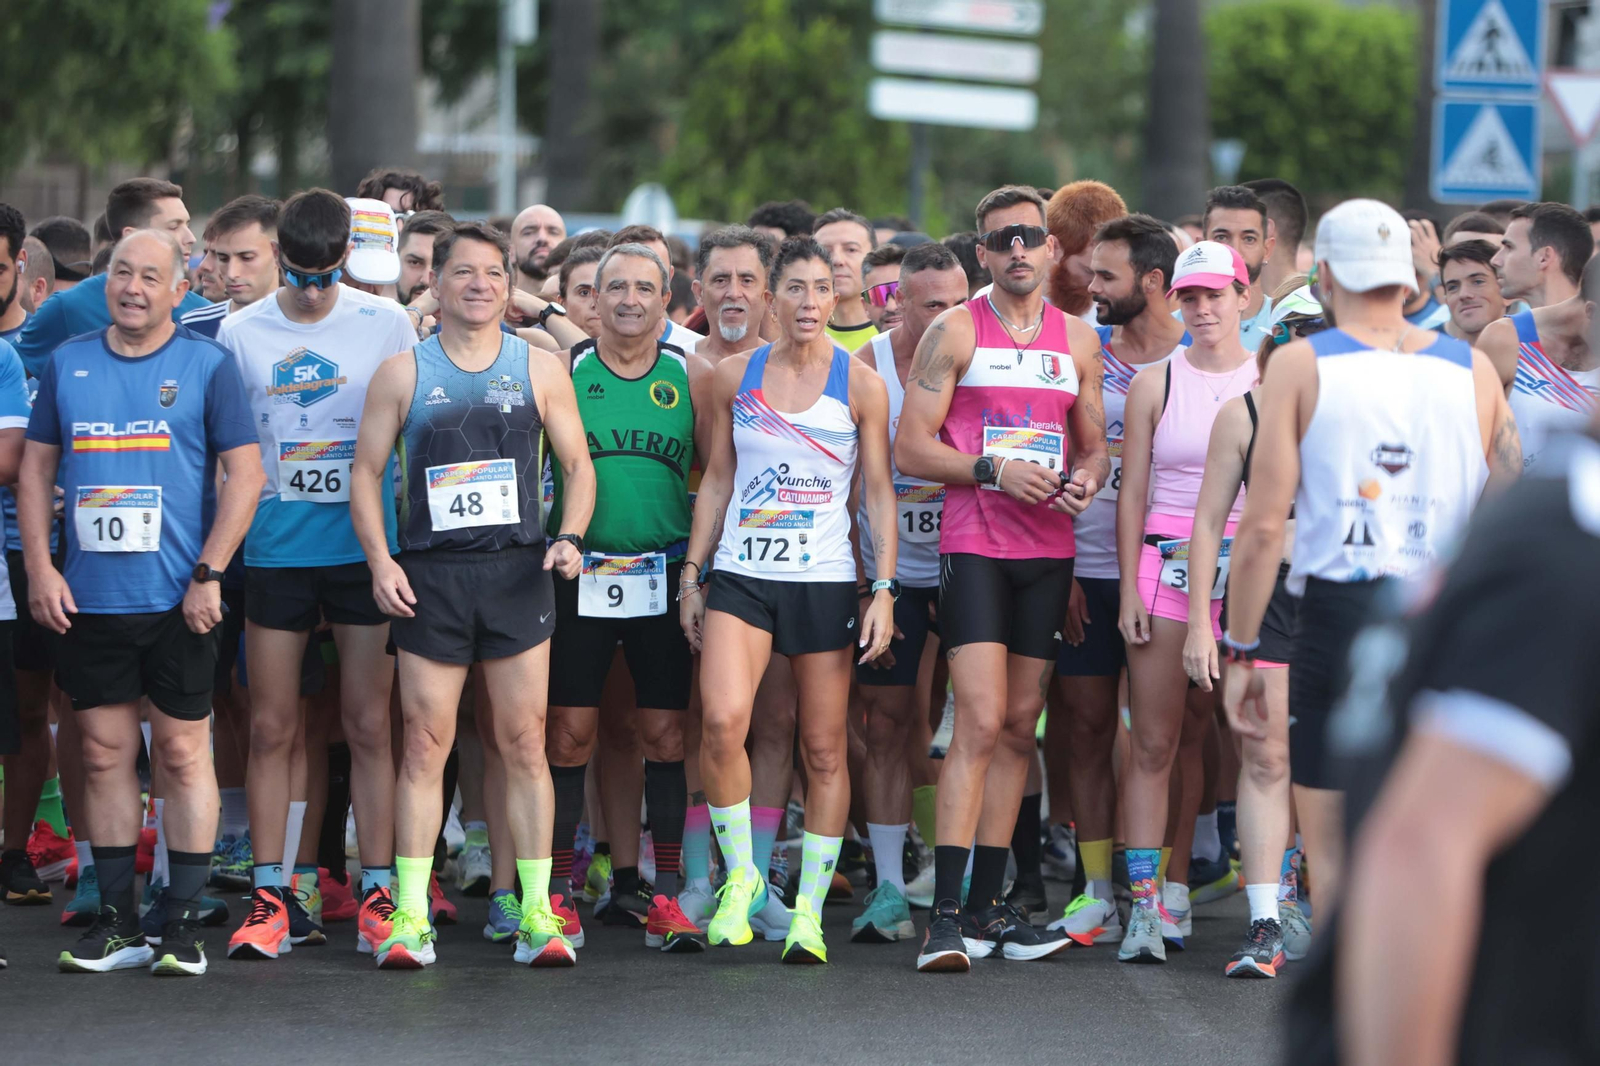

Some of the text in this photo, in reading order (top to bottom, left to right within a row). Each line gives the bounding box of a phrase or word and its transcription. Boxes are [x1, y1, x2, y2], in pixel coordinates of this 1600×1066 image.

[293, 364, 322, 382] 5K
[611, 429, 688, 467] VERDE
[991, 433, 1057, 446] CARRERA POPULAR
[289, 469, 342, 493] 426
[434, 465, 509, 479] CARRERA POPULAR
[472, 474, 492, 482] SANTO
[82, 492, 154, 500] CARRERA POPULAR
[741, 475, 761, 502] Jerez
[448, 491, 485, 518] 48
[92, 516, 125, 541] 10
[742, 536, 790, 562] 172
[606, 583, 624, 608] 9
